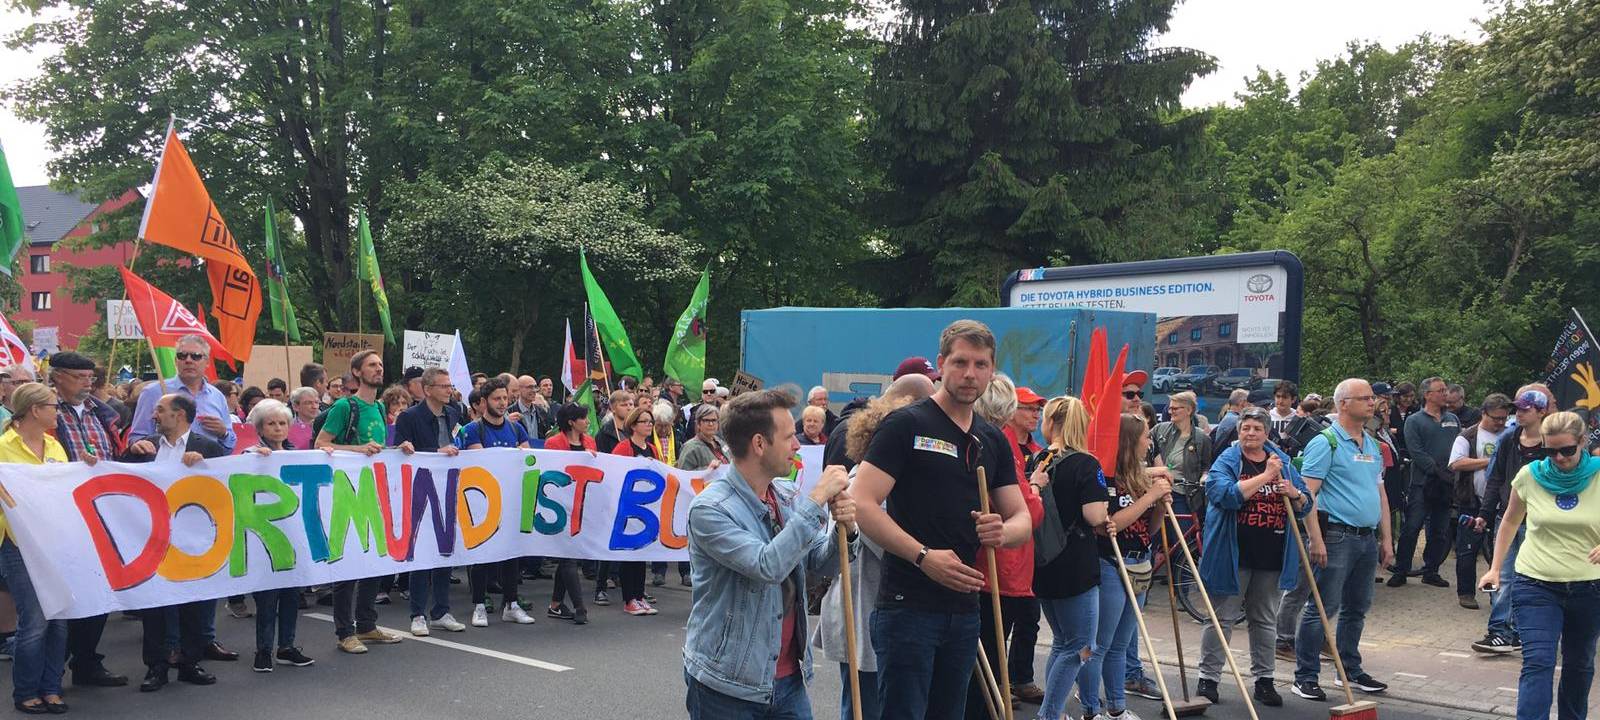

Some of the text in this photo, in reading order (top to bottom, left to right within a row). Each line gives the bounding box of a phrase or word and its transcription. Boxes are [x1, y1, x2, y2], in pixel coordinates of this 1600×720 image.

[1021, 282, 1215, 303] DIE TOYOTA HYBRID BUSINESS EDITION.
[1244, 294, 1275, 302] TOYOTA
[113, 304, 135, 316] DOR
[1085, 299, 1126, 309] TESTEN.
[113, 324, 145, 337] BUN
[73, 461, 502, 591] DORTMUND
[608, 469, 708, 551] BU
